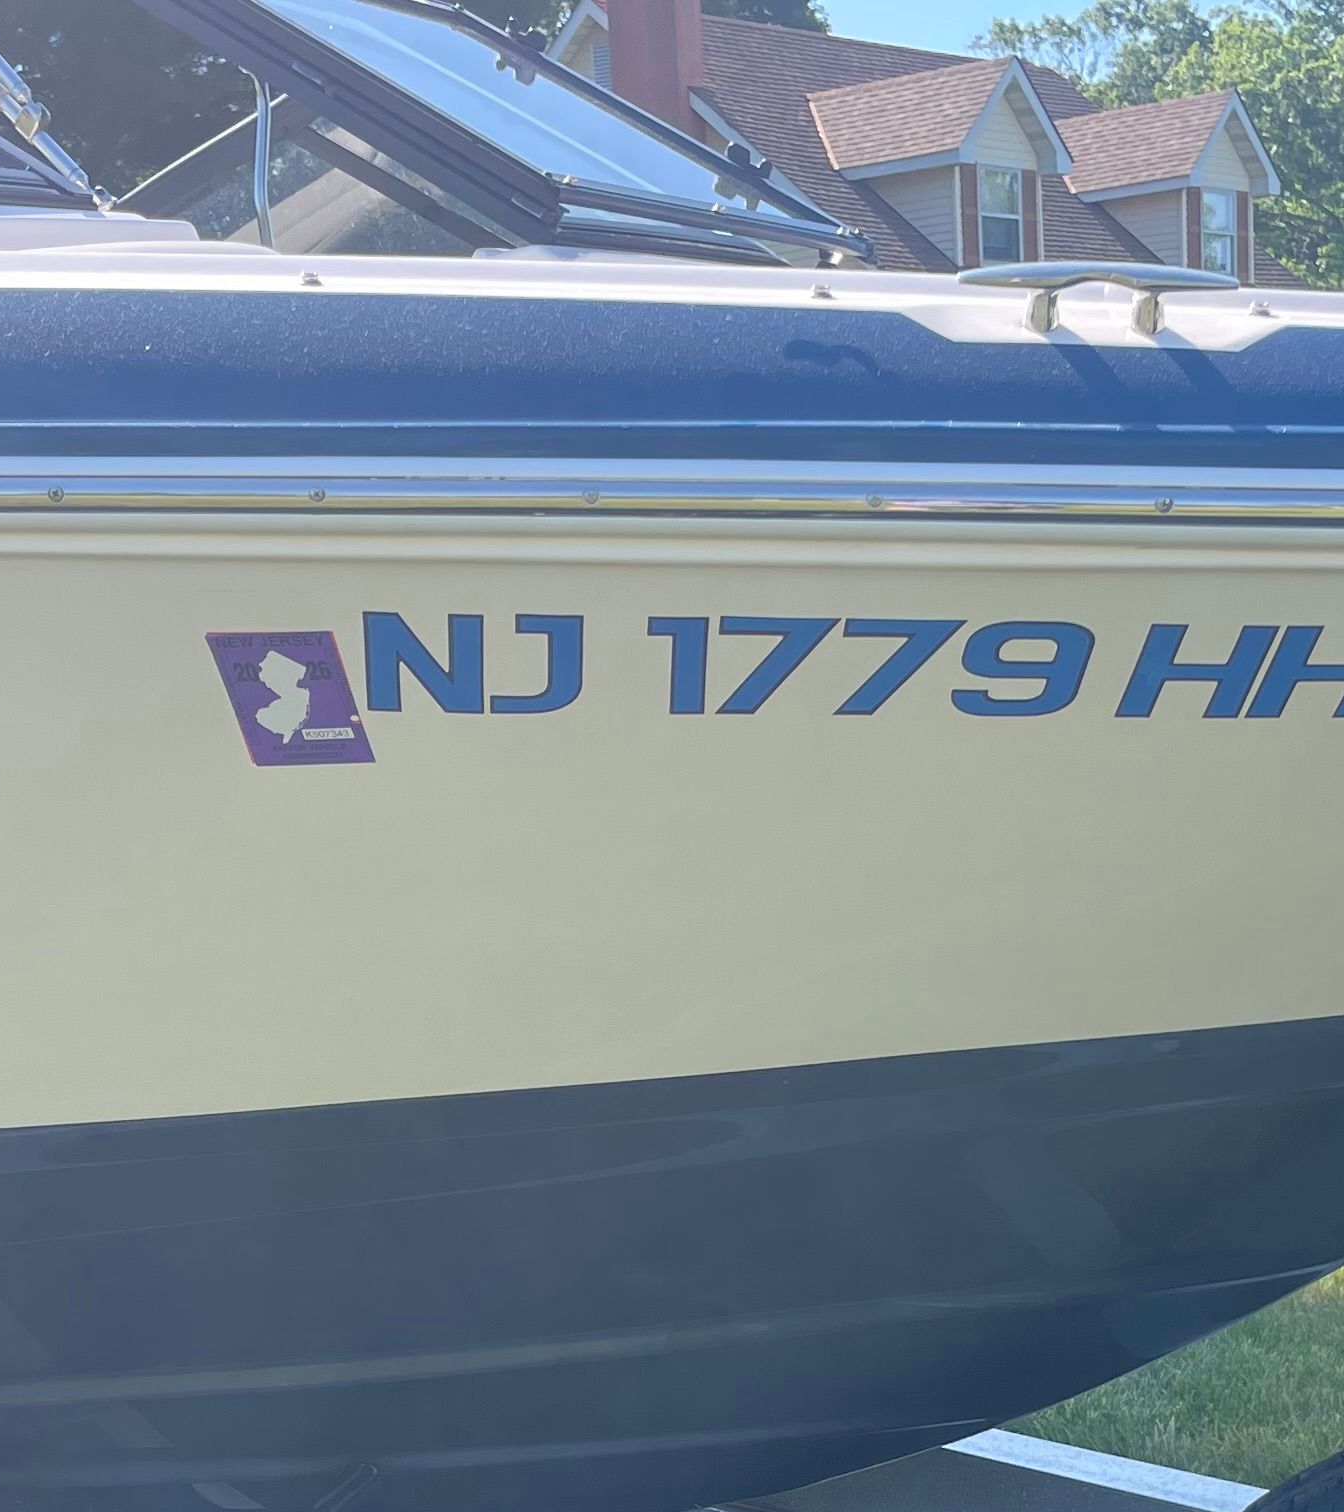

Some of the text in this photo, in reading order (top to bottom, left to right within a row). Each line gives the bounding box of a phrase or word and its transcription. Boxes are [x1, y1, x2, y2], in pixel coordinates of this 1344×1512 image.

[215, 634, 323, 648] NEW JERSEY
[233, 660, 332, 682] 20 26
[362, 610, 585, 714] NJ
[647, 616, 1096, 717] 1779
